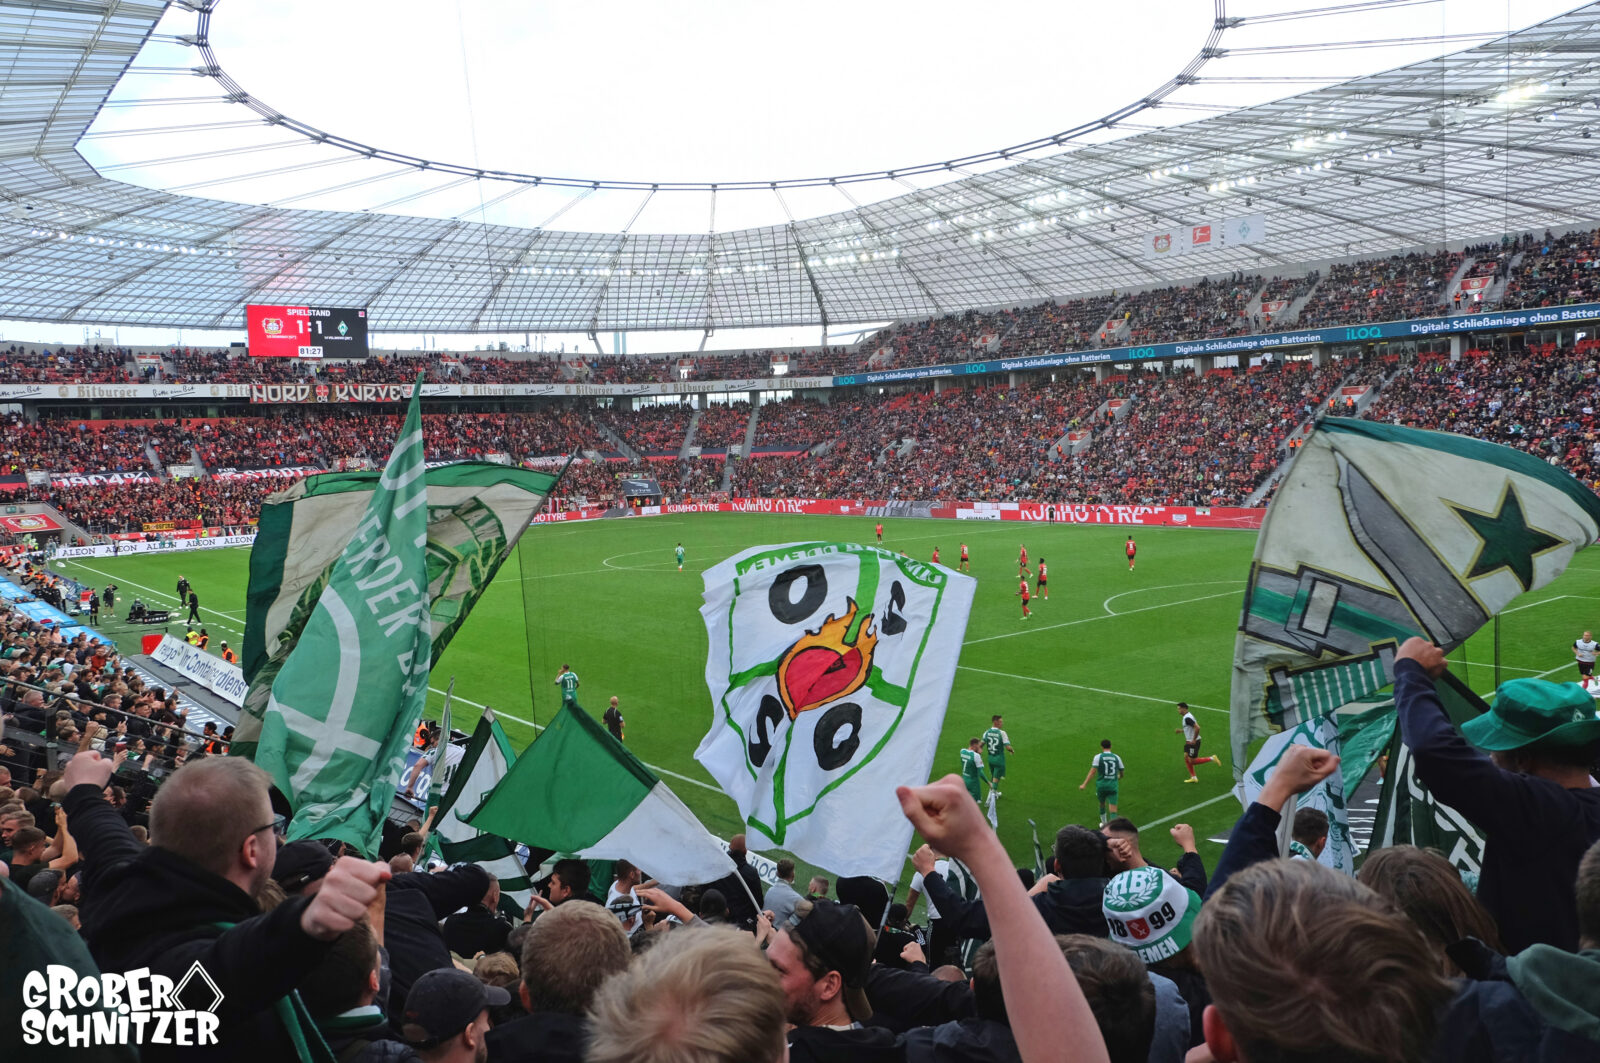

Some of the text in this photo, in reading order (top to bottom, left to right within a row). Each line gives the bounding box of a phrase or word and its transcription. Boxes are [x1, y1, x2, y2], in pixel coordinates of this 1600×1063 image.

[287, 308, 331, 317] SPIELSTAND
[1411, 321, 1450, 334] Digitale
[1452, 313, 1527, 330] Schließanlage
[1530, 312, 1560, 323] ohne
[1346, 327, 1382, 341] iLOQ
[1175, 333, 1321, 355] Digitale Schließanlage ohne Batterien
[299, 348, 322, 356] 81:27
[1128, 347, 1155, 360] iLOQ
[965, 363, 987, 374] iLOQ
[1001, 353, 1111, 371] Digitale Schließanlage ohne Batterien
[838, 376, 855, 386] iLOQ
[867, 367, 952, 382] Digitale Schließanlage ohne Batterien
[473, 385, 515, 395] Bitburger
[576, 385, 613, 395] Bitburger
[673, 381, 715, 394] Bitburger
[779, 379, 822, 390] Bitburger
[77, 385, 139, 398] Bitburger
[252, 384, 310, 402] NORD
[335, 384, 401, 402] KURVE
[667, 503, 719, 513] KUMHO TYRE
[547, 512, 567, 522] TYRE
[224, 536, 253, 545] ALEON
[62, 546, 96, 557] ALEON
[987, 736, 1000, 751] 32
[961, 758, 968, 772] 7
[1103, 760, 1116, 776] 13
